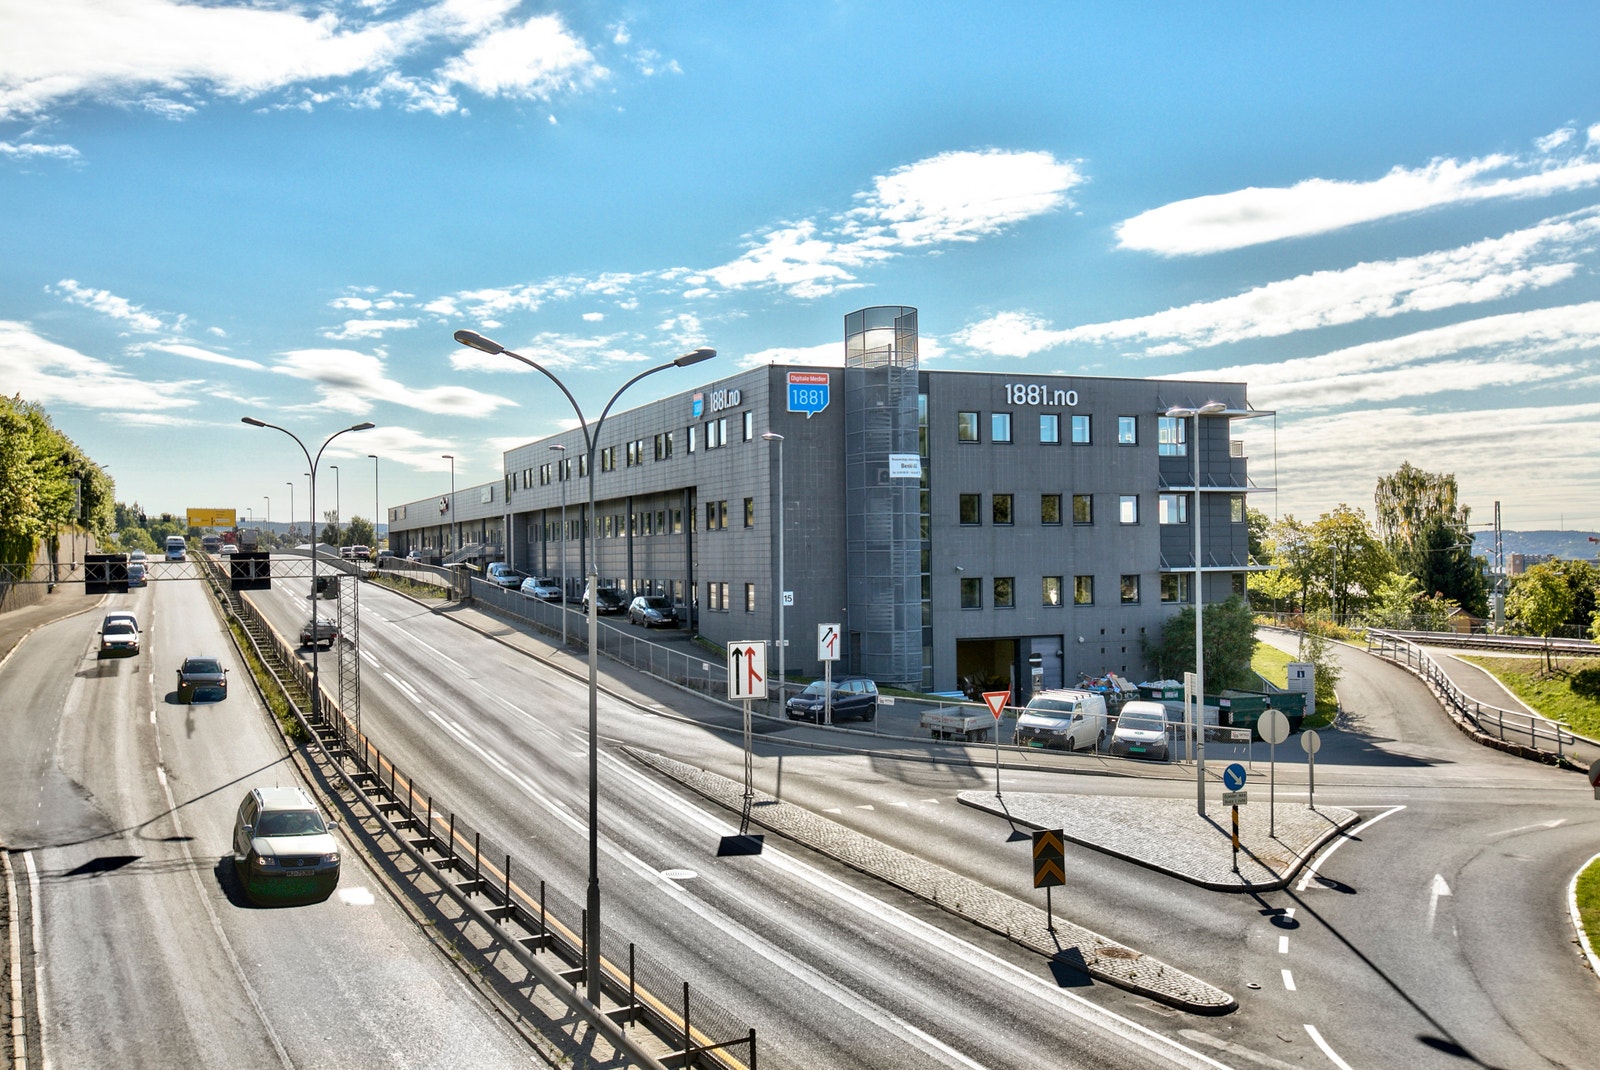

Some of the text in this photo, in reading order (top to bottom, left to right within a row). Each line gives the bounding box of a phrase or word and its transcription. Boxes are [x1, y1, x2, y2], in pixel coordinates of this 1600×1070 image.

[710, 389, 740, 412] 1881.no
[792, 389, 824, 405] 1881
[1005, 383, 1079, 406] 1881.no
[784, 594, 793, 603] 15
